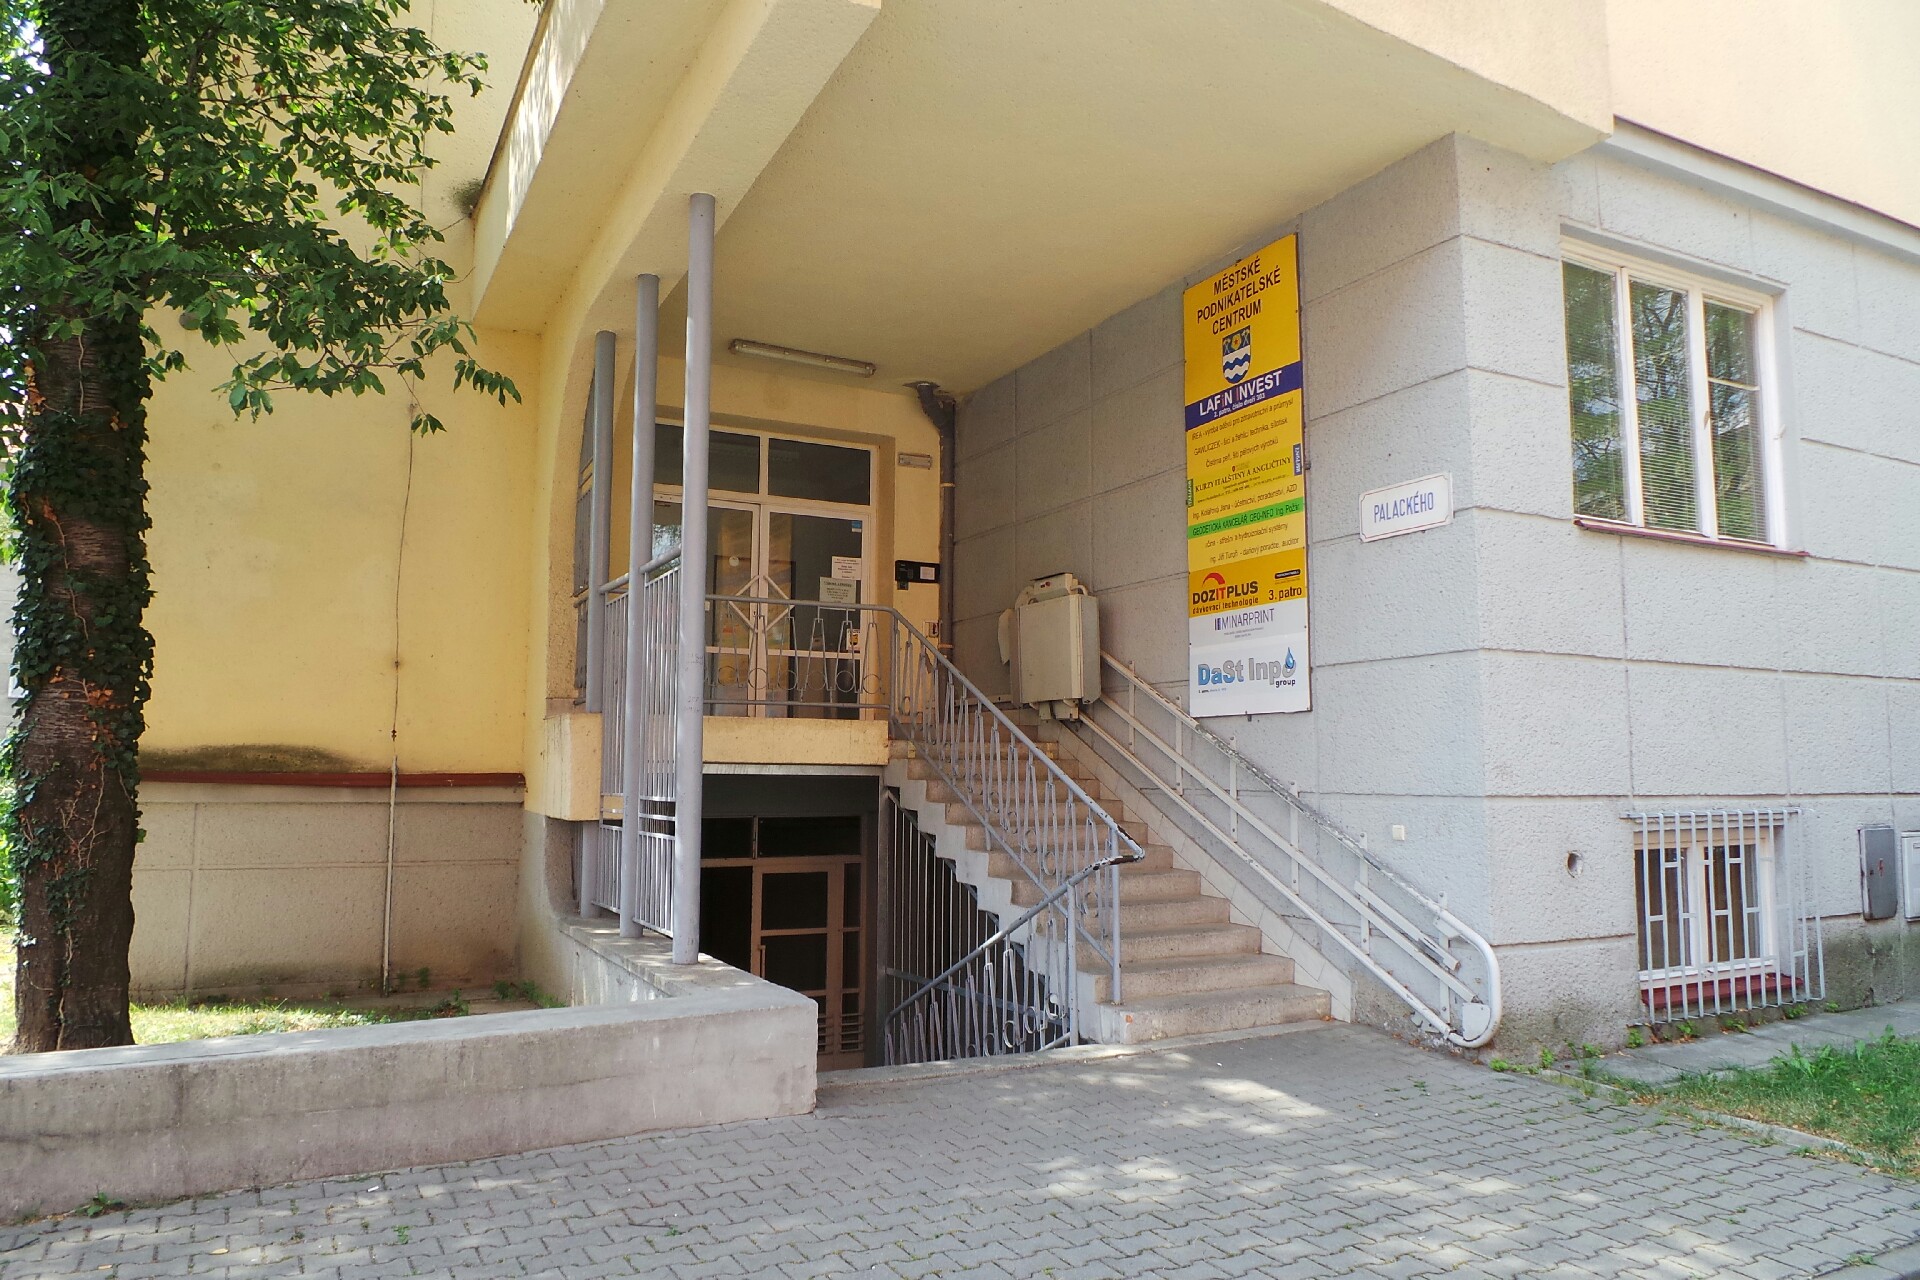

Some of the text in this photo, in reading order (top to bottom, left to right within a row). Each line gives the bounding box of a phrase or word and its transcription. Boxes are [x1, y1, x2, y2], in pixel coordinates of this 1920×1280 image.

[1214, 256, 1260, 295] MĚSTSKÉ
[1197, 265, 1280, 324] PODNIKATELSKÉ
[1212, 299, 1261, 334] CENTRUM
[1236, 370, 1282, 400] INVEST
[1195, 481, 1213, 492] KURZY
[1214, 470, 1245, 486] ITALŠTINY
[1252, 456, 1290, 474] ANGLIČTINY
[1374, 491, 1434, 522] PALACKÉHO
[1193, 581, 1258, 604] DOZITPLUS
[1222, 596, 1258, 609] technologie
[1269, 586, 1301, 601] 3. patro
[1198, 660, 1244, 685] DaSt
[1276, 678, 1295, 688] group
